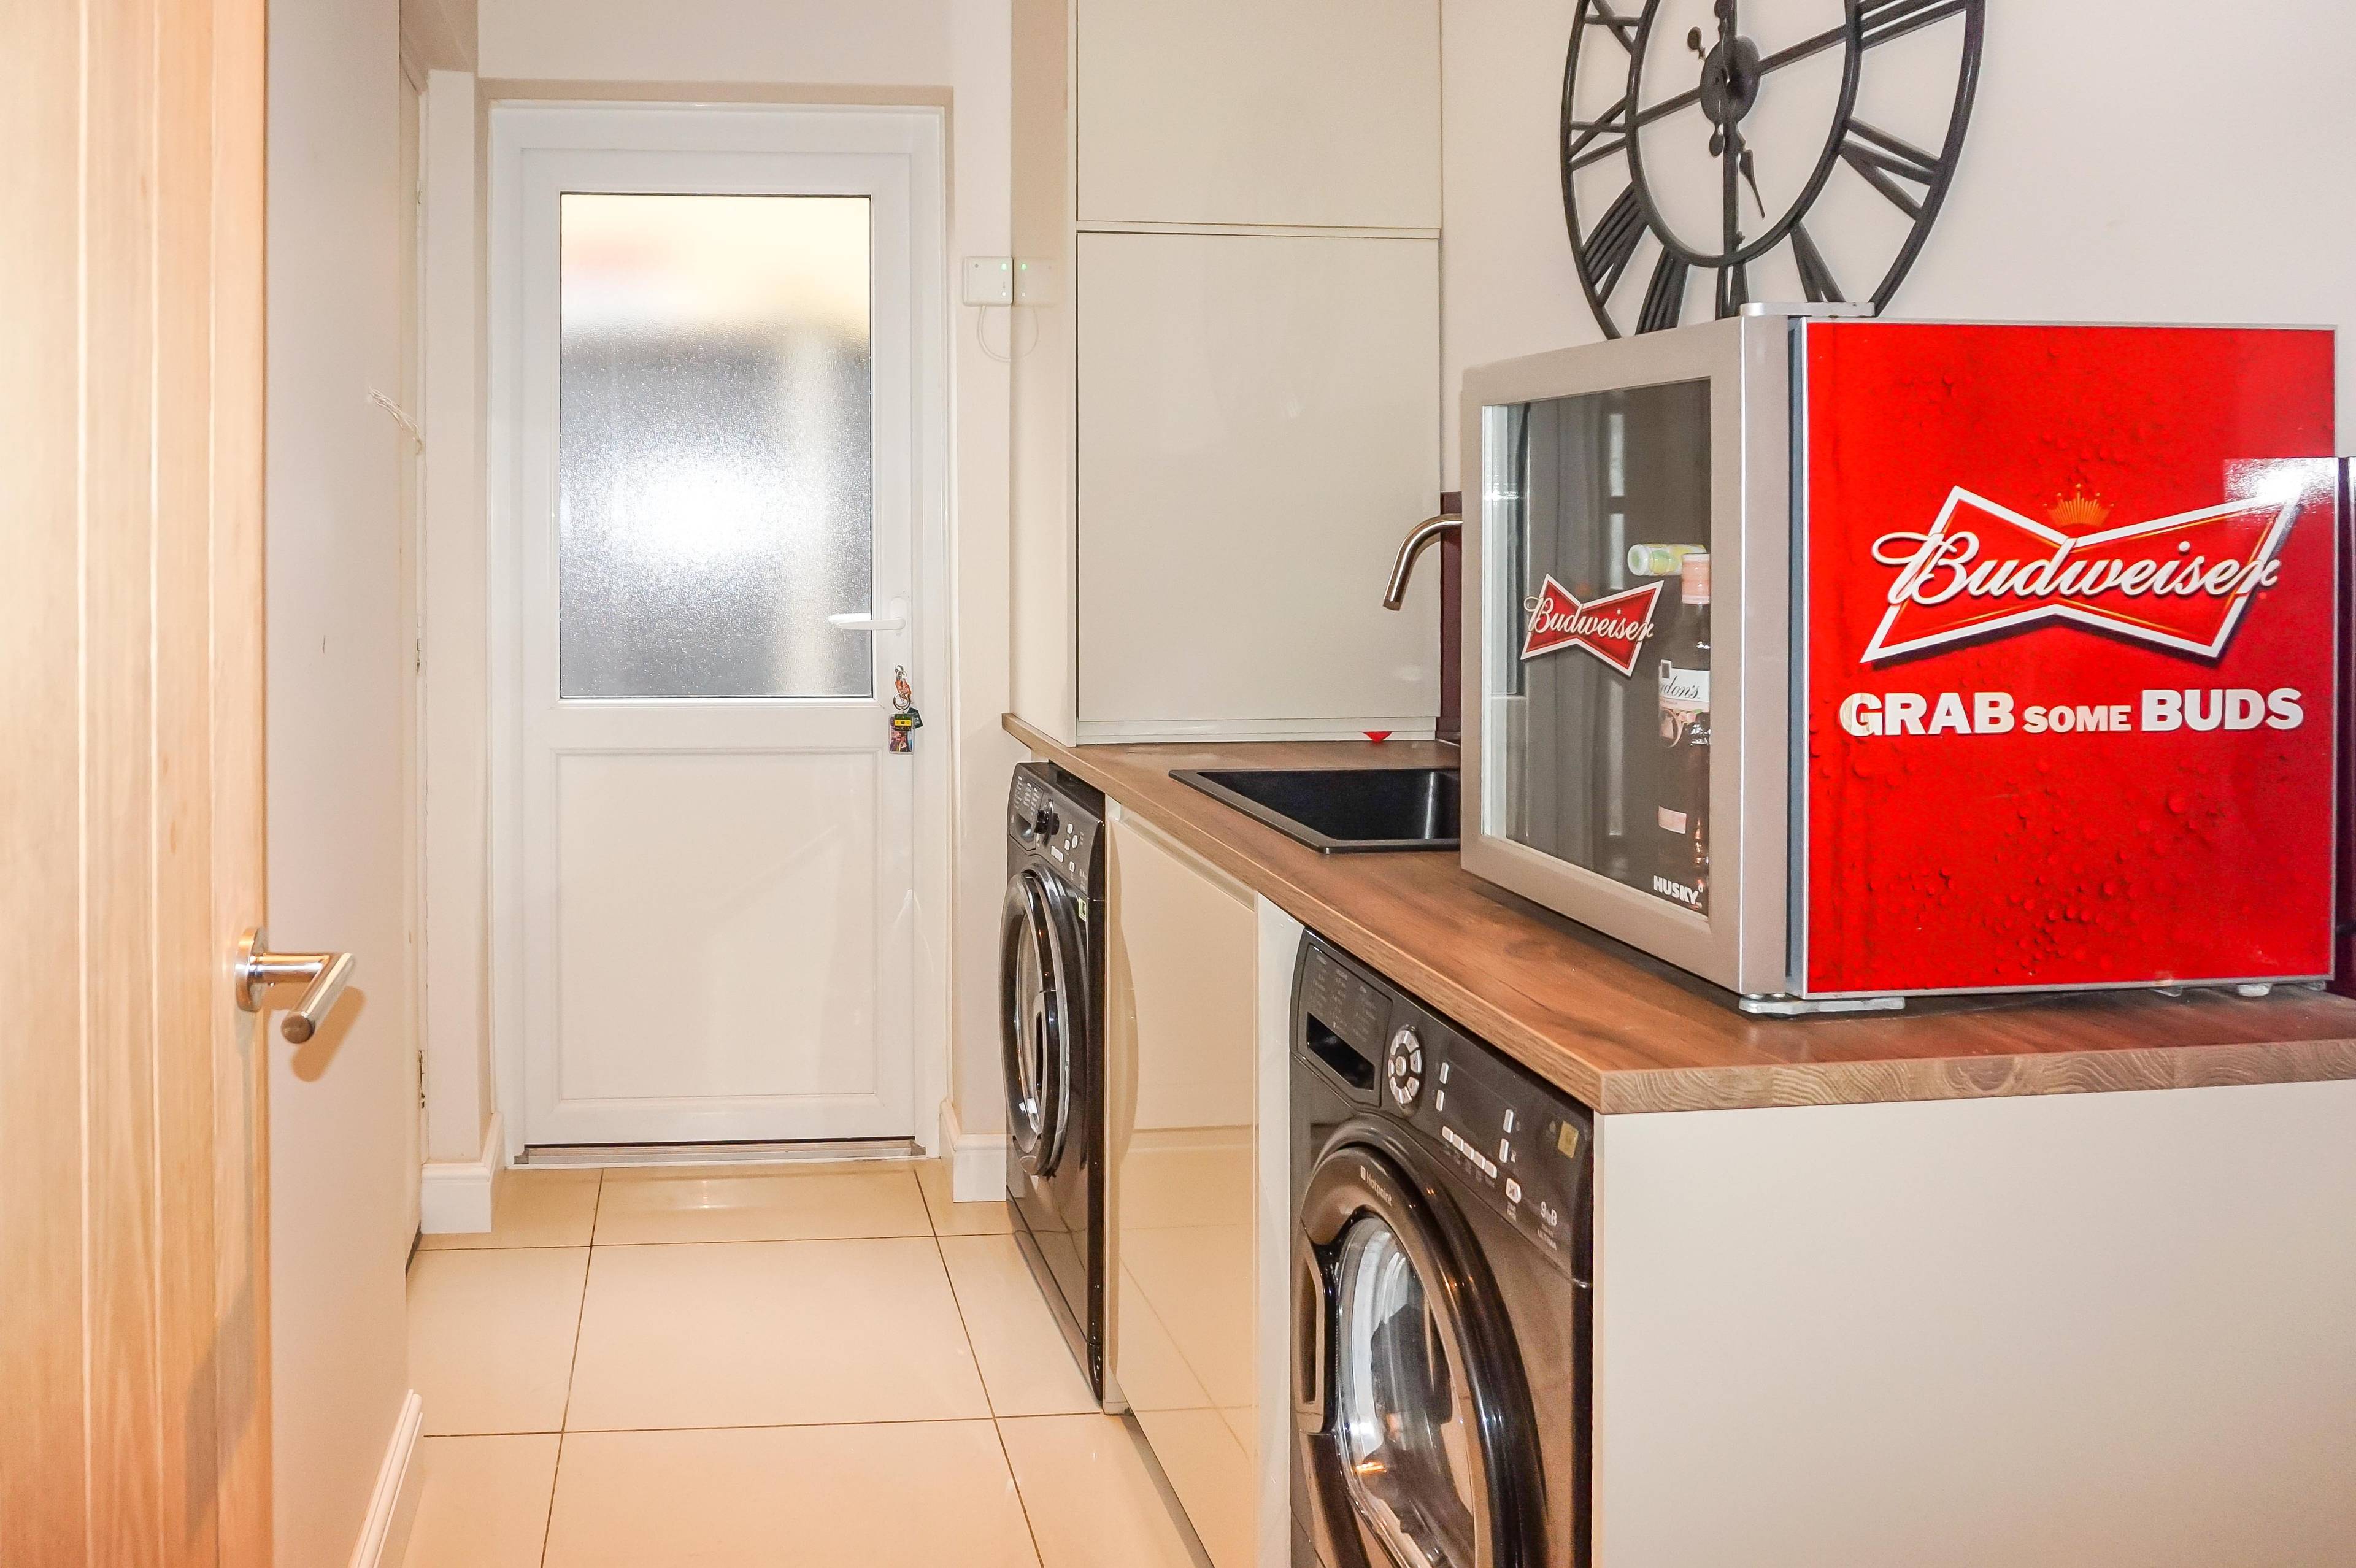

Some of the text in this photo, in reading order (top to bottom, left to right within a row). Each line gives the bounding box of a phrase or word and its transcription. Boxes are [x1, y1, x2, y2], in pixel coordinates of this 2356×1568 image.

[1872, 530, 2281, 605] Budweiser
[1523, 596, 1654, 641] Budweiser
[1839, 688, 2304, 736] GRAB SOME BUDS
[1653, 875, 1699, 905] HUSKY
[1366, 1171, 1392, 1207] Hotpoint
